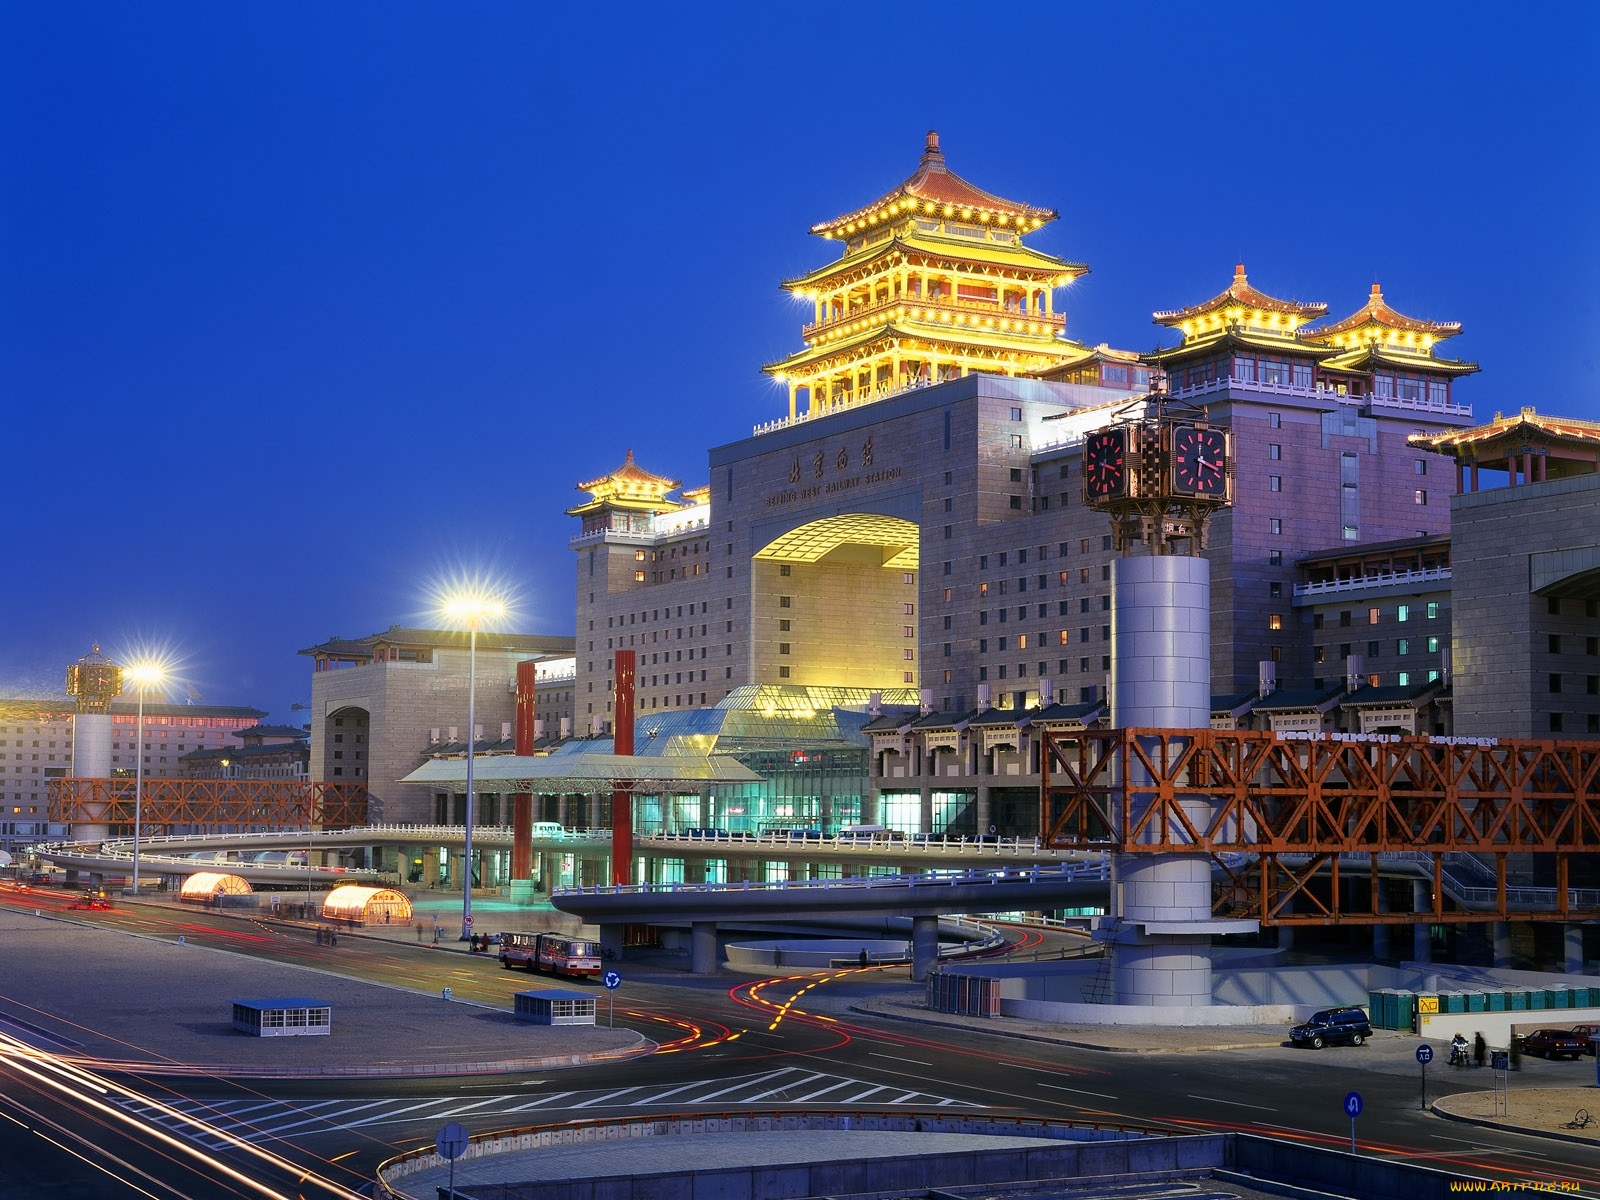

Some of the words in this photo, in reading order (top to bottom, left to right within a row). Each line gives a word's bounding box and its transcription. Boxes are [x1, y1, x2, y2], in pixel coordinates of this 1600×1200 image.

[789, 436, 874, 483] 北京西站
[765, 491, 797, 507] BEIJING
[800, 486, 821, 499] WEST
[825, 477, 860, 494] RAILWAY
[864, 467, 901, 485] STATION
[1420, 1000, 1438, 1012] 入口
